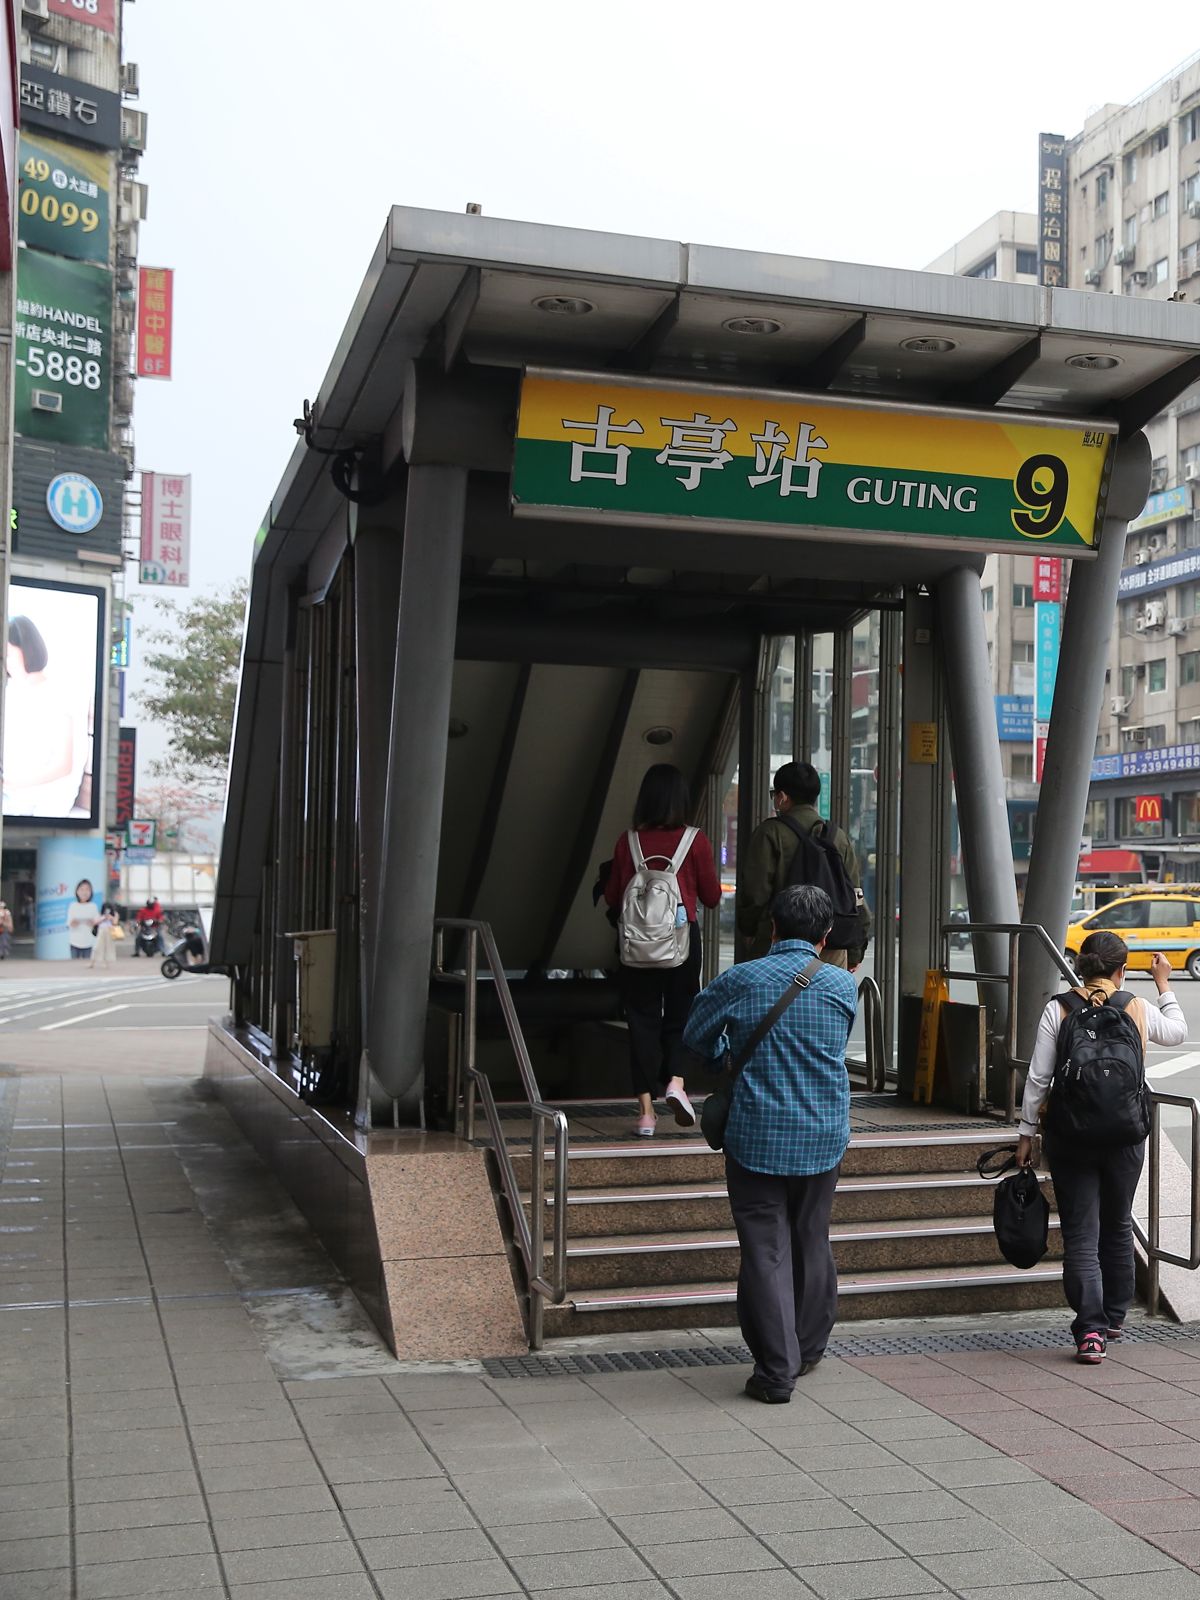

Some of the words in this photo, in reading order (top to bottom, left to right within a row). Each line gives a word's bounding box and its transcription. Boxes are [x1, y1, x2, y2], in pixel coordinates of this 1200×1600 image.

[21, 188, 99, 232] 0099
[24, 157, 50, 182] 49
[562, 405, 829, 499] 古亭站
[846, 477, 978, 514] GUTING
[1010, 453, 1071, 538] 9
[160, 479, 185, 565] 博士眼科
[117, 740, 134, 825] FRIDAYS
